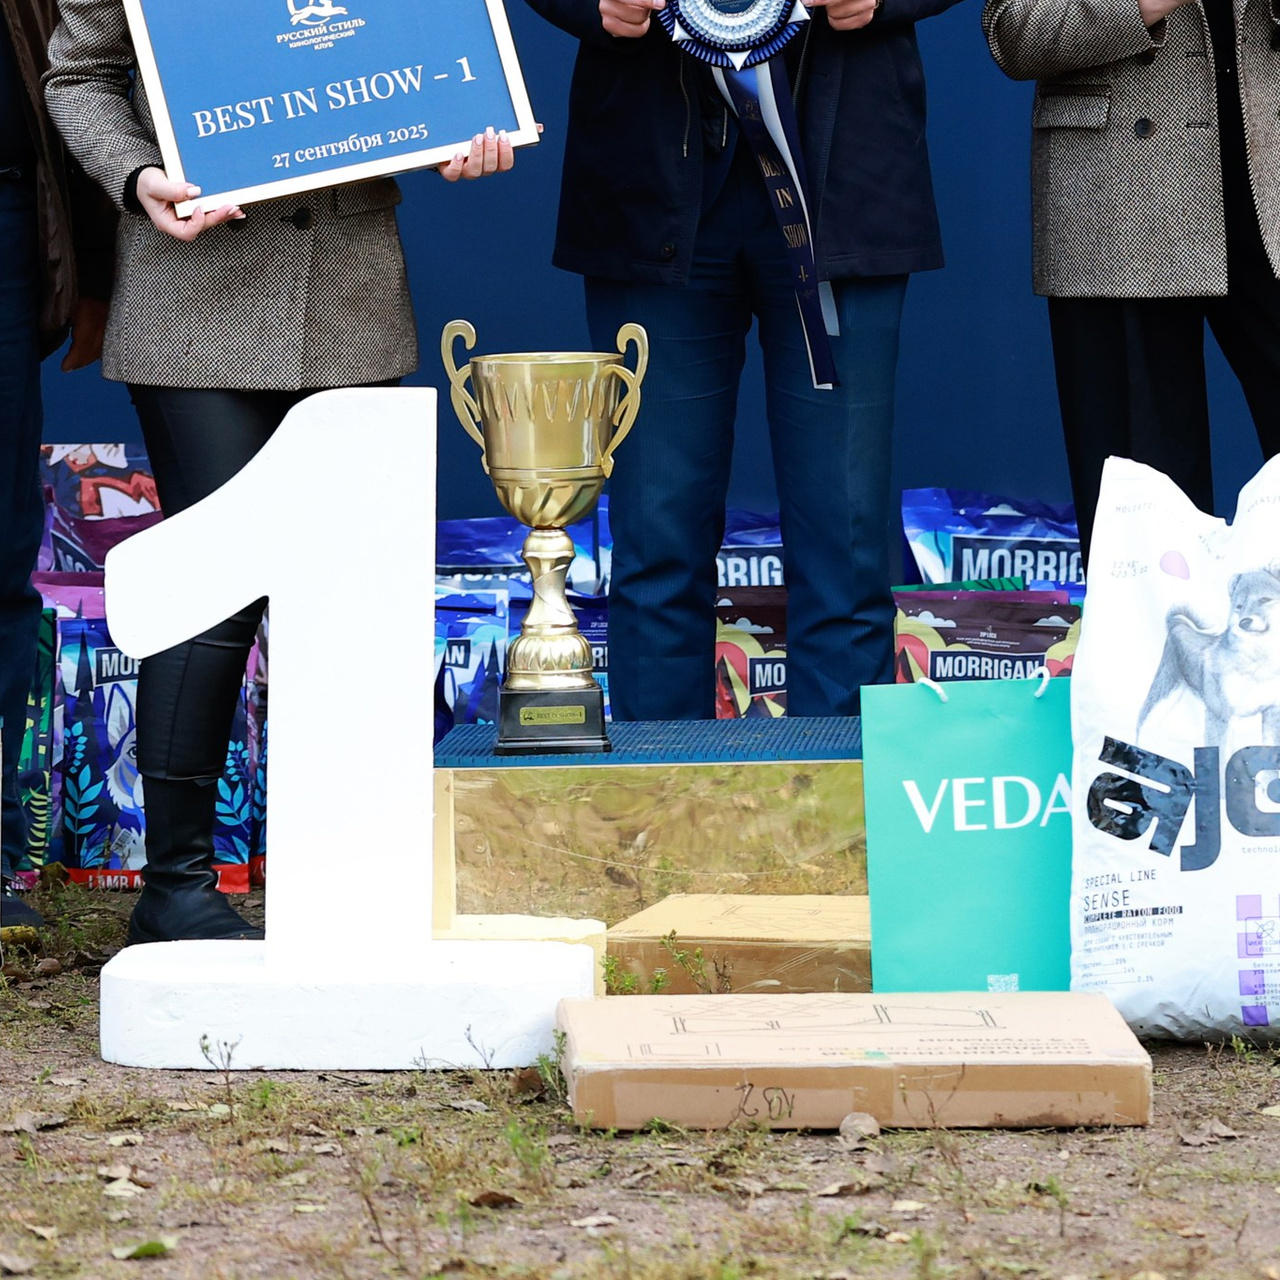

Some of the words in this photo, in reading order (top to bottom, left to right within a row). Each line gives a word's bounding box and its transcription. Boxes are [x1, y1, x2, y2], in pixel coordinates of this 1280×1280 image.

[276, 23, 328, 43] РУССКИЙ
[329, 18, 366, 32] СТИЛЬ
[314, 41, 334, 51] КЛУБ
[192, 95, 275, 138] BEST
[281, 87, 318, 120] IN
[325, 65, 424, 110] SHOW
[456, 56, 477, 83] 1
[271, 152, 290, 169] 27
[294, 133, 384, 163] сентября
[388, 123, 429, 144] 2025
[774, 186, 795, 210] IN
[782, 223, 808, 249] SHOW
[935, 655, 1041, 681] MORRIGAN
[902, 773, 1072, 833] VEDA
[1085, 872, 1123, 889] SPECIAL
[1130, 869, 1157, 882] LINE
[1084, 889, 1130, 912] SENSE
[1159, 906, 1183, 915] FOOD
[1152, 918, 1175, 926] КОРМ
